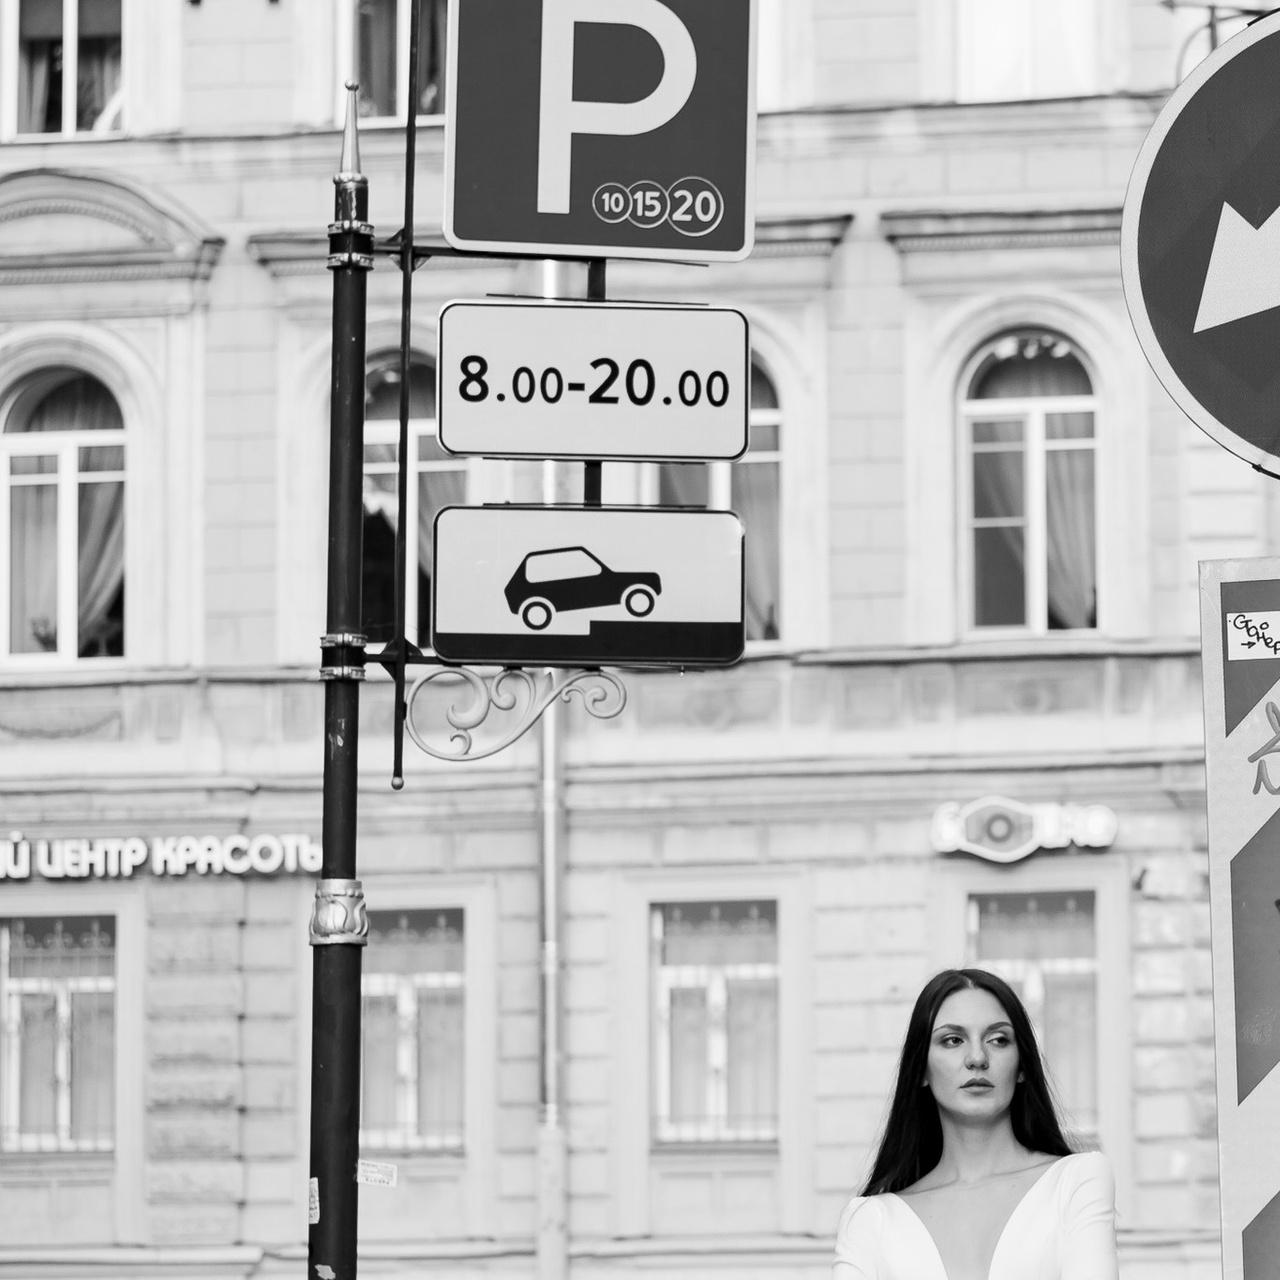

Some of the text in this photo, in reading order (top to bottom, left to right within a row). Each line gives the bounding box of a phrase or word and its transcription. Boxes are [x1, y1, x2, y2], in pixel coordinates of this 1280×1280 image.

[601, 189, 717, 222] 10 15 20
[0, 830, 31, 879] Й
[37, 836, 149, 878] ЦЕНТР
